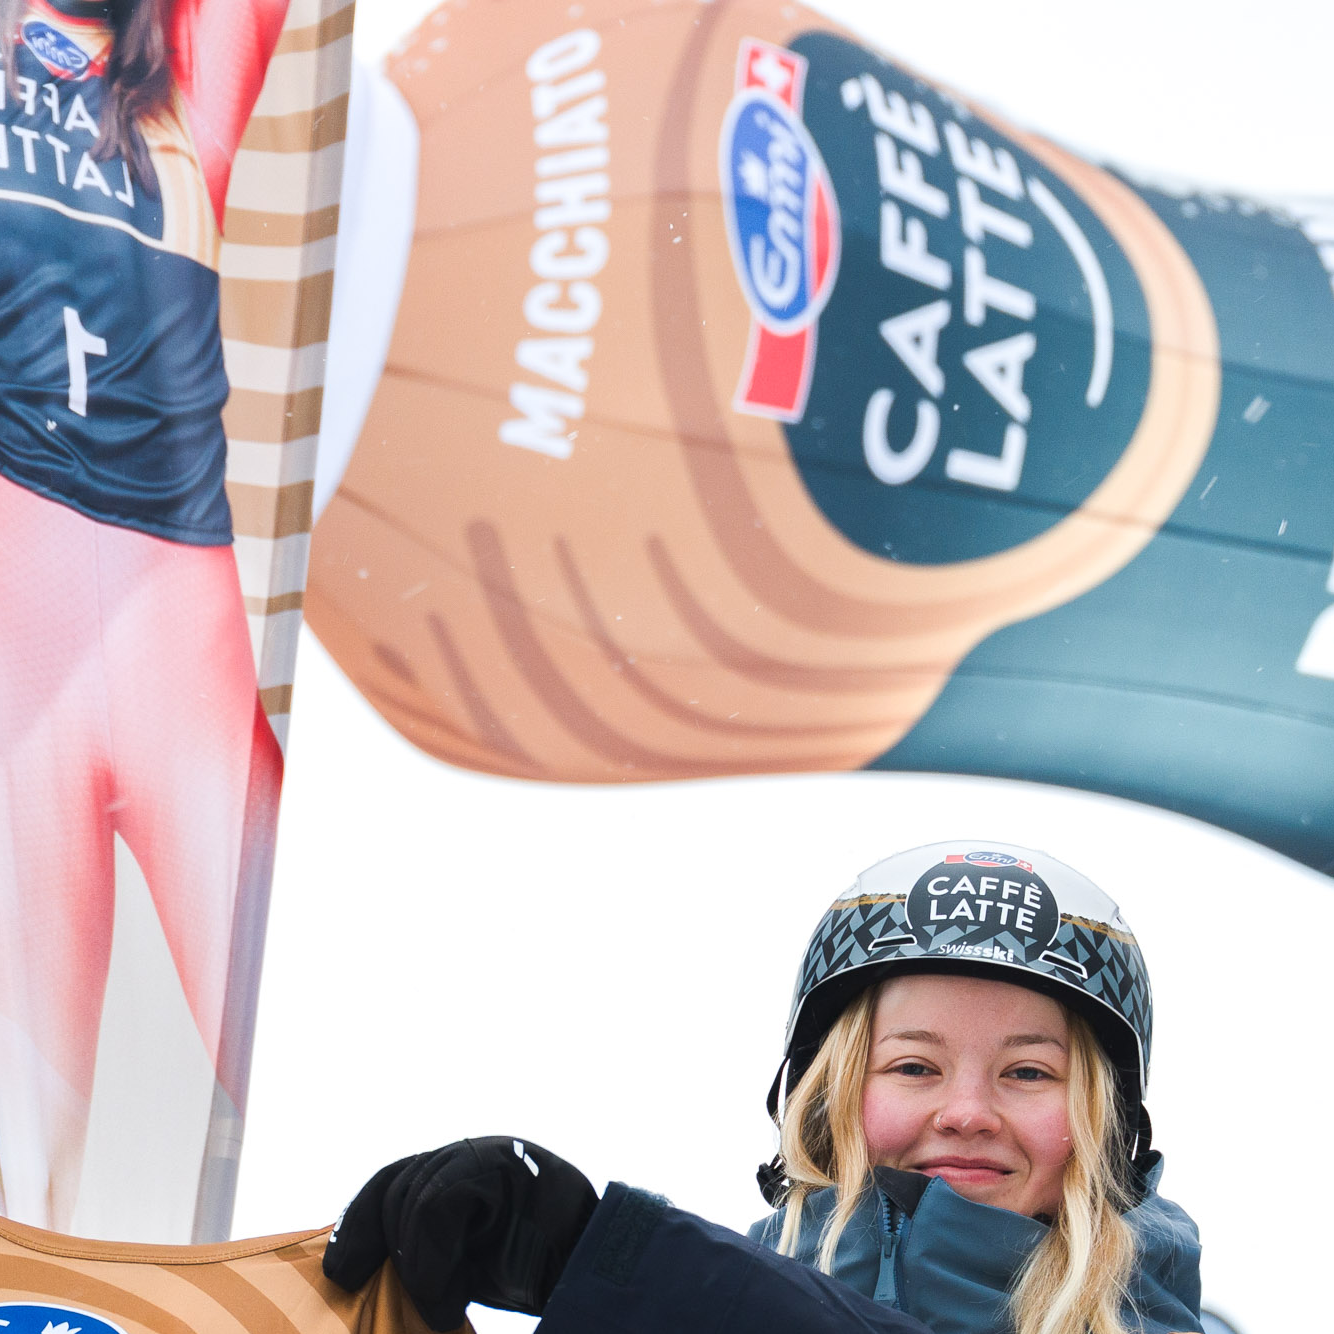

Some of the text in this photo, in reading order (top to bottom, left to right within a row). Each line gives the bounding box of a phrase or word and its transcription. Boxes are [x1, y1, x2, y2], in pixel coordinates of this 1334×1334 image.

[498, 27, 612, 461] MACCHIATO
[749, 110, 806, 309] Emmi
[841, 72, 953, 486] CAFFÈ
[945, 120, 1038, 493] LATTE
[927, 875, 1043, 910] CAFFÈ
[929, 898, 1037, 933] LATTE
[968, 852, 1013, 865] Emmi
